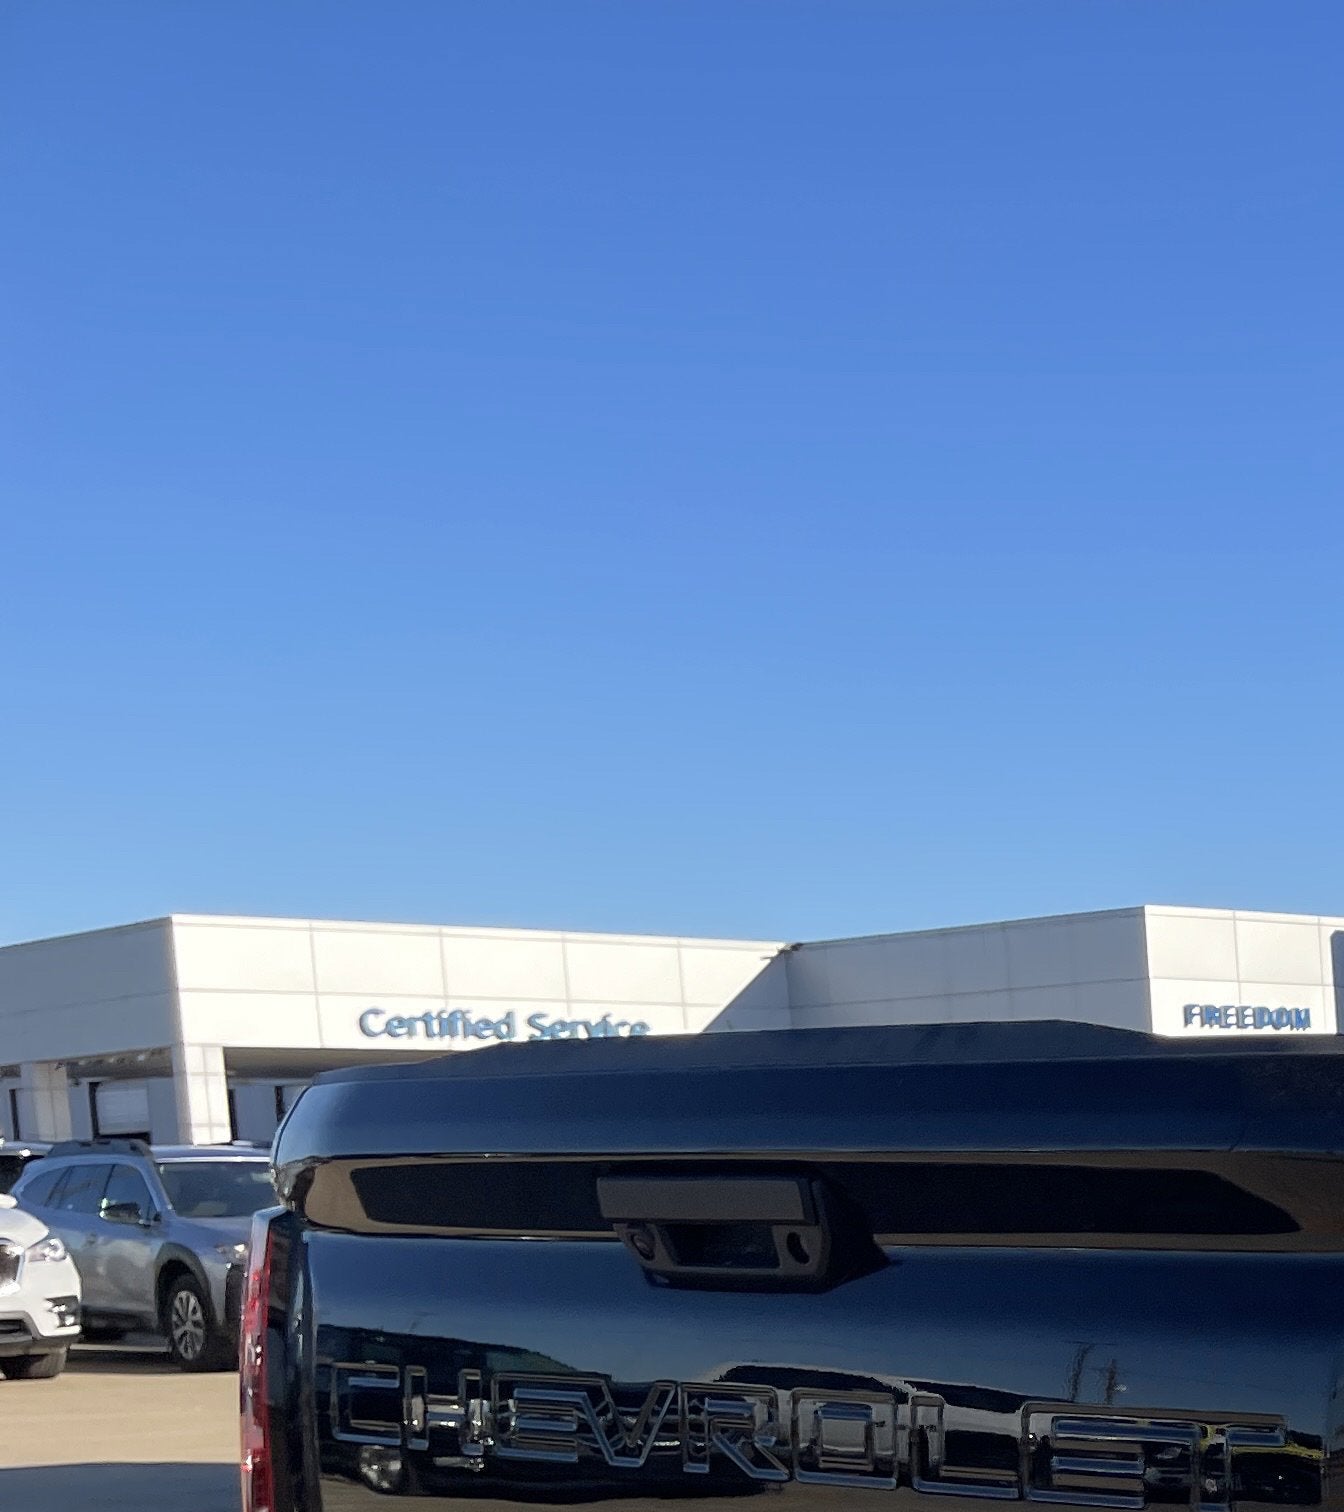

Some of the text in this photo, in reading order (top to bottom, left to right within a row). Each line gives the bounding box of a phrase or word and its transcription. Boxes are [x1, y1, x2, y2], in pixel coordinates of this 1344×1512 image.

[359, 1008, 651, 1041] Certified Service
[1183, 1004, 1311, 1031] FREEDOM
